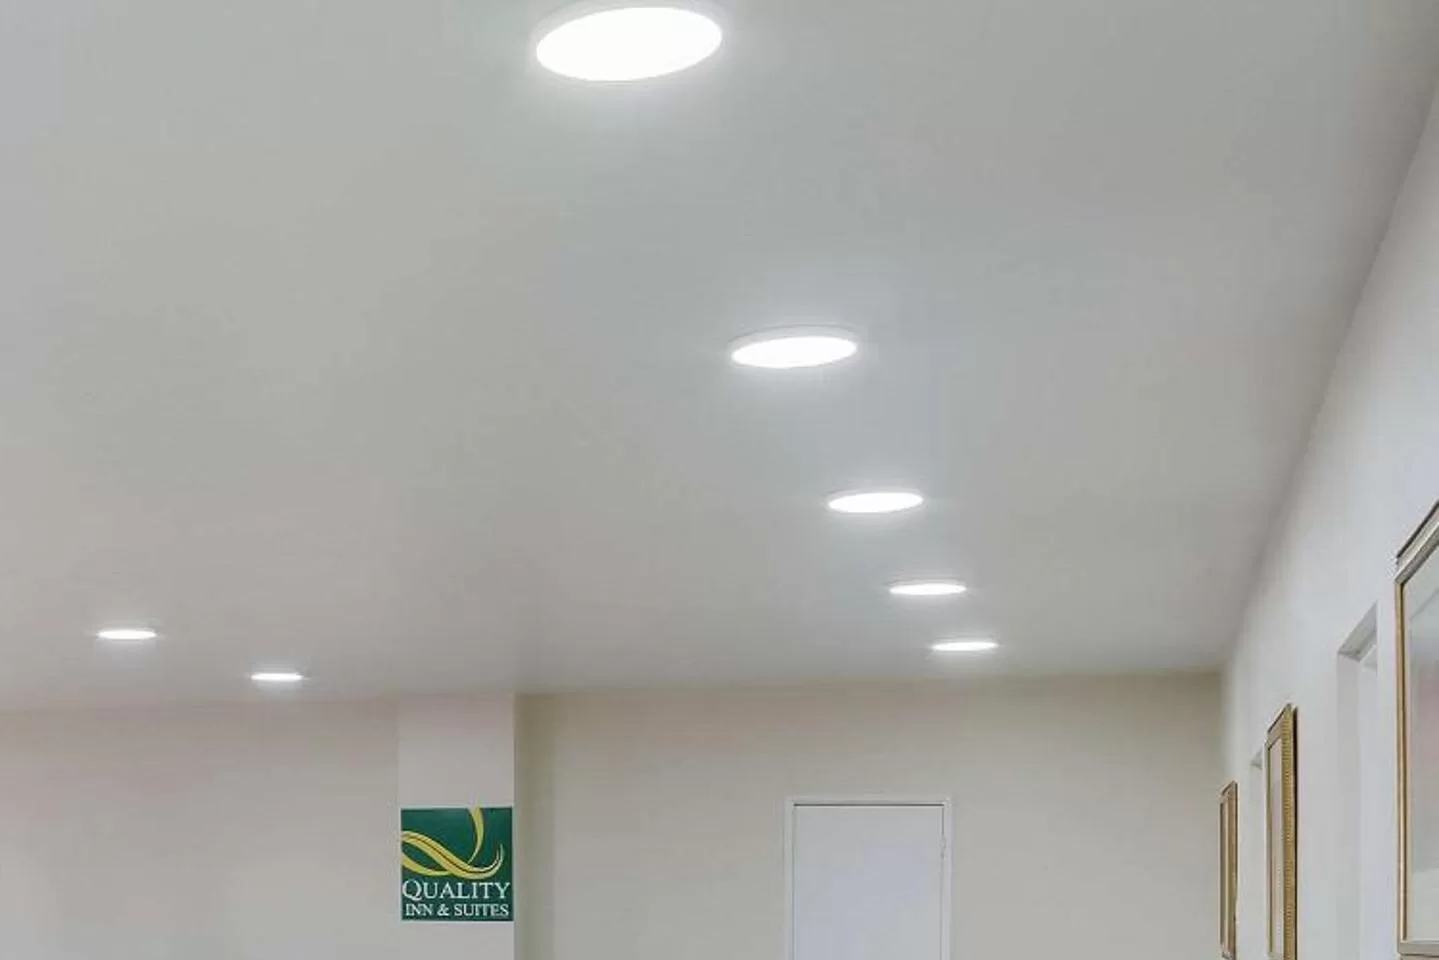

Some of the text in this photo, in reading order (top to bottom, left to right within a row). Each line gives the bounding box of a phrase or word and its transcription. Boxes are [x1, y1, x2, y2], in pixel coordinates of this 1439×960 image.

[402, 879, 510, 901] QUALITY
[405, 903, 509, 917] INN & SUITES
